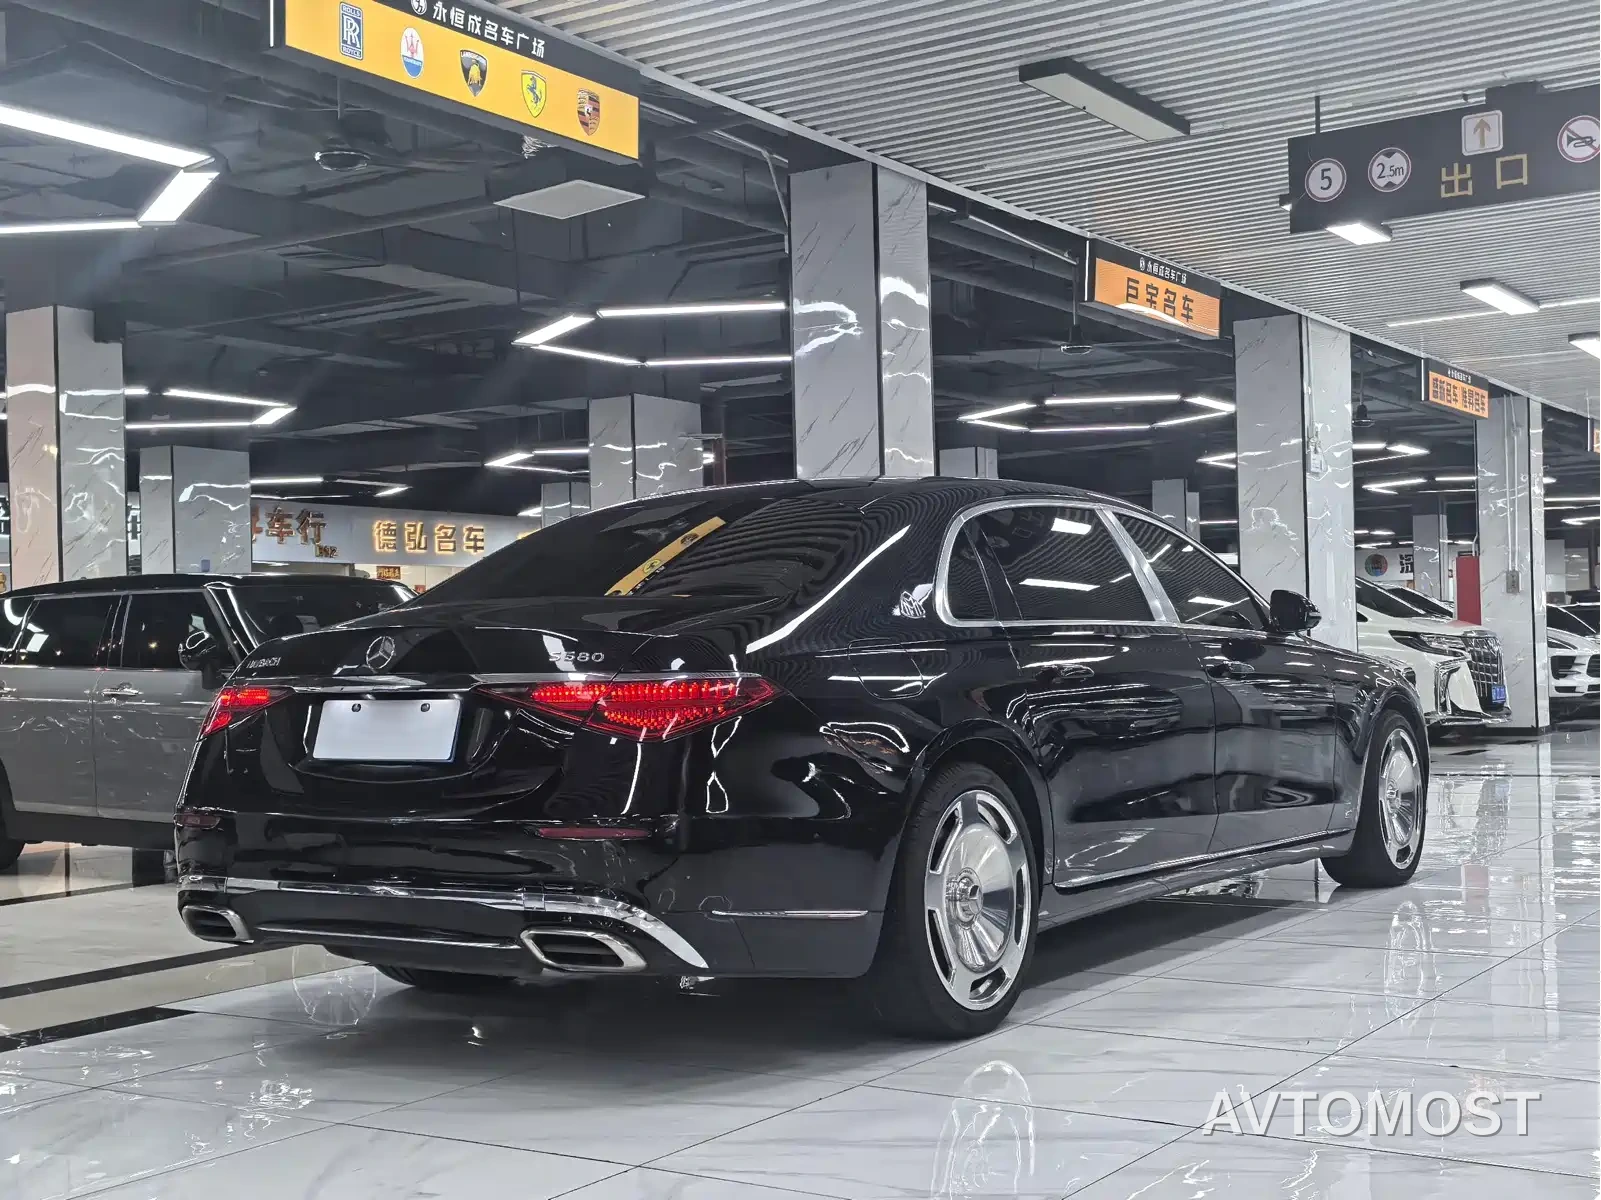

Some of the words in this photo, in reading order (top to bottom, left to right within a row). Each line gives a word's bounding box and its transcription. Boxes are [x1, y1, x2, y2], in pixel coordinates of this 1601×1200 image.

[432, 1, 545, 58] 永恒成名车广场
[1320, 168, 1332, 190] 5
[1376, 162, 1404, 179] 2.5m
[1440, 154, 1528, 198] 出口
[1126, 276, 1194, 322] 巨宝名车
[374, 520, 486, 554] 德弘名车
[549, 651, 605, 662] S580
